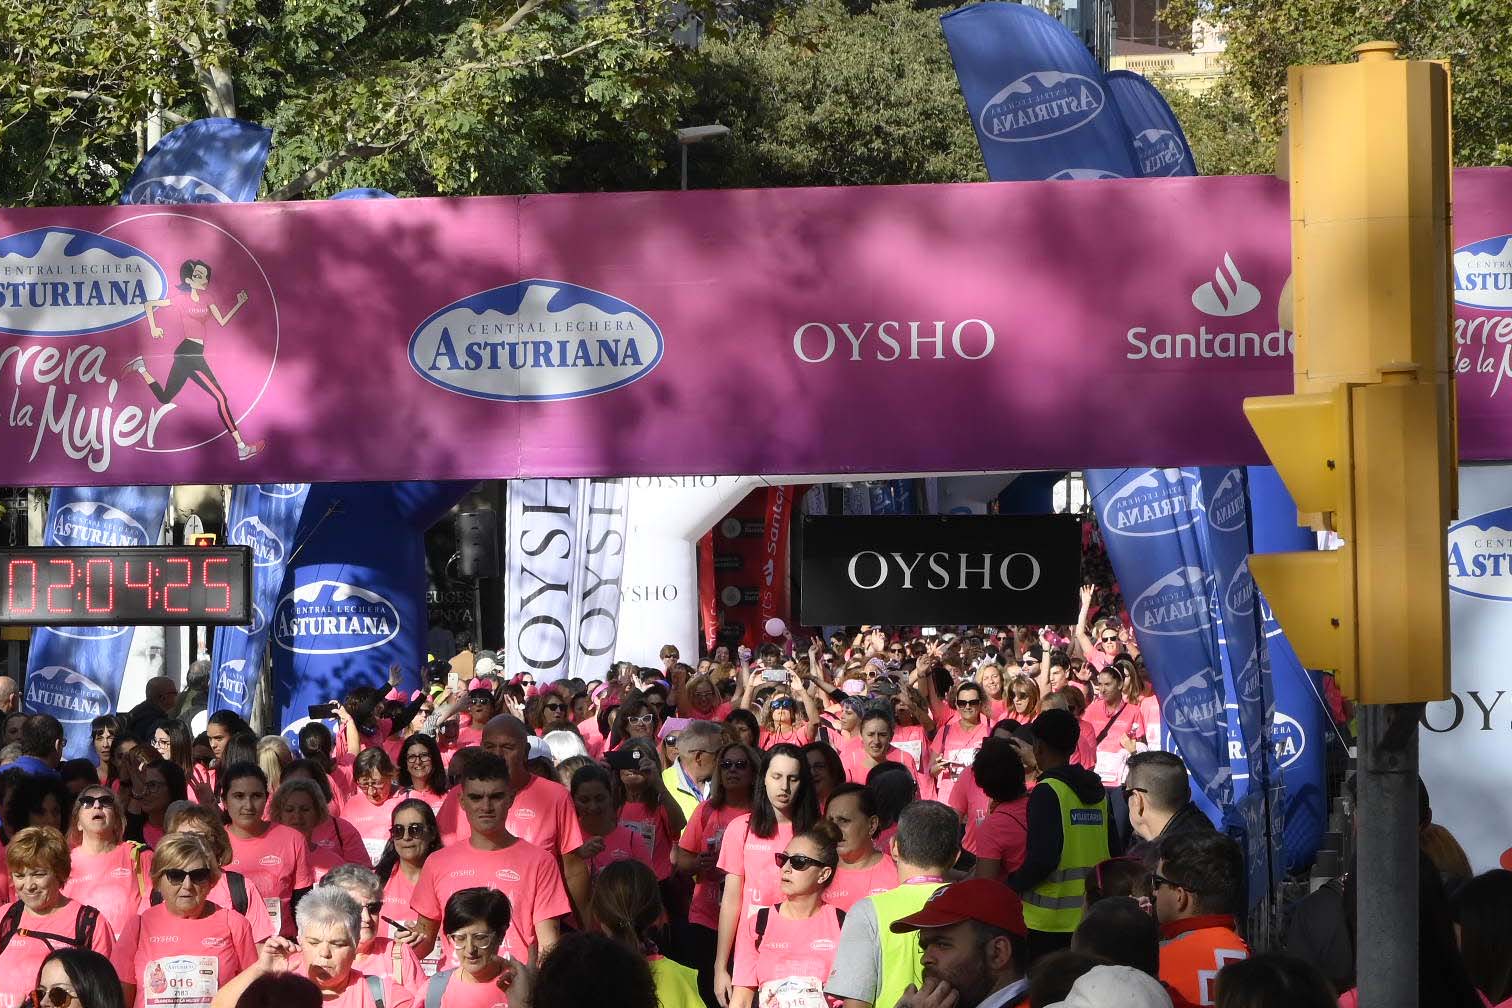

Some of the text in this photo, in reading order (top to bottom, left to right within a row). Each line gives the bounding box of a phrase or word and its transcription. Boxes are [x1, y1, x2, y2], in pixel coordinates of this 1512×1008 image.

[71, 262, 143, 275] LECHERA
[467, 319, 636, 336] CENTRAL LECHERA
[793, 318, 996, 363] OYSHO
[1125, 326, 1296, 361] Santand
[427, 326, 644, 371] ASTURIANA
[1477, 346, 1494, 373] la
[9, 388, 34, 427] la
[29, 378, 177, 473] Mujer
[8, 558, 231, 613] 02:04:25
[847, 550, 1041, 591] OYSHO
[277, 611, 391, 639] ASTURIANA
[1419, 691, 1512, 733] OY
[169, 978, 193, 988] 016
